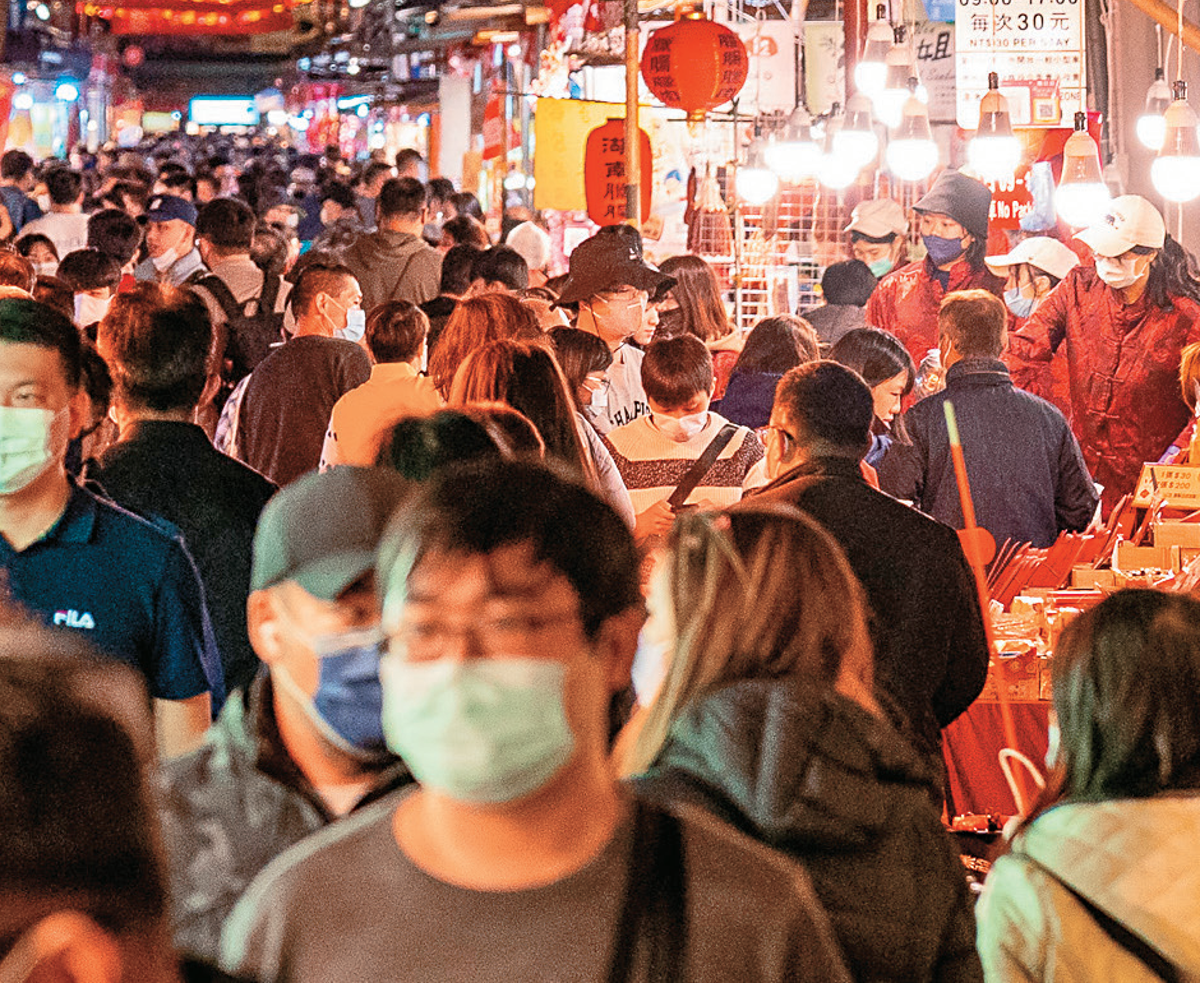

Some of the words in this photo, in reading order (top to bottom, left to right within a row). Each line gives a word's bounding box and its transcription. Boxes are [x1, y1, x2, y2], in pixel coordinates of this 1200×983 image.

[971, 12, 1070, 32] 每次30元
[53, 609, 95, 629] FILA
